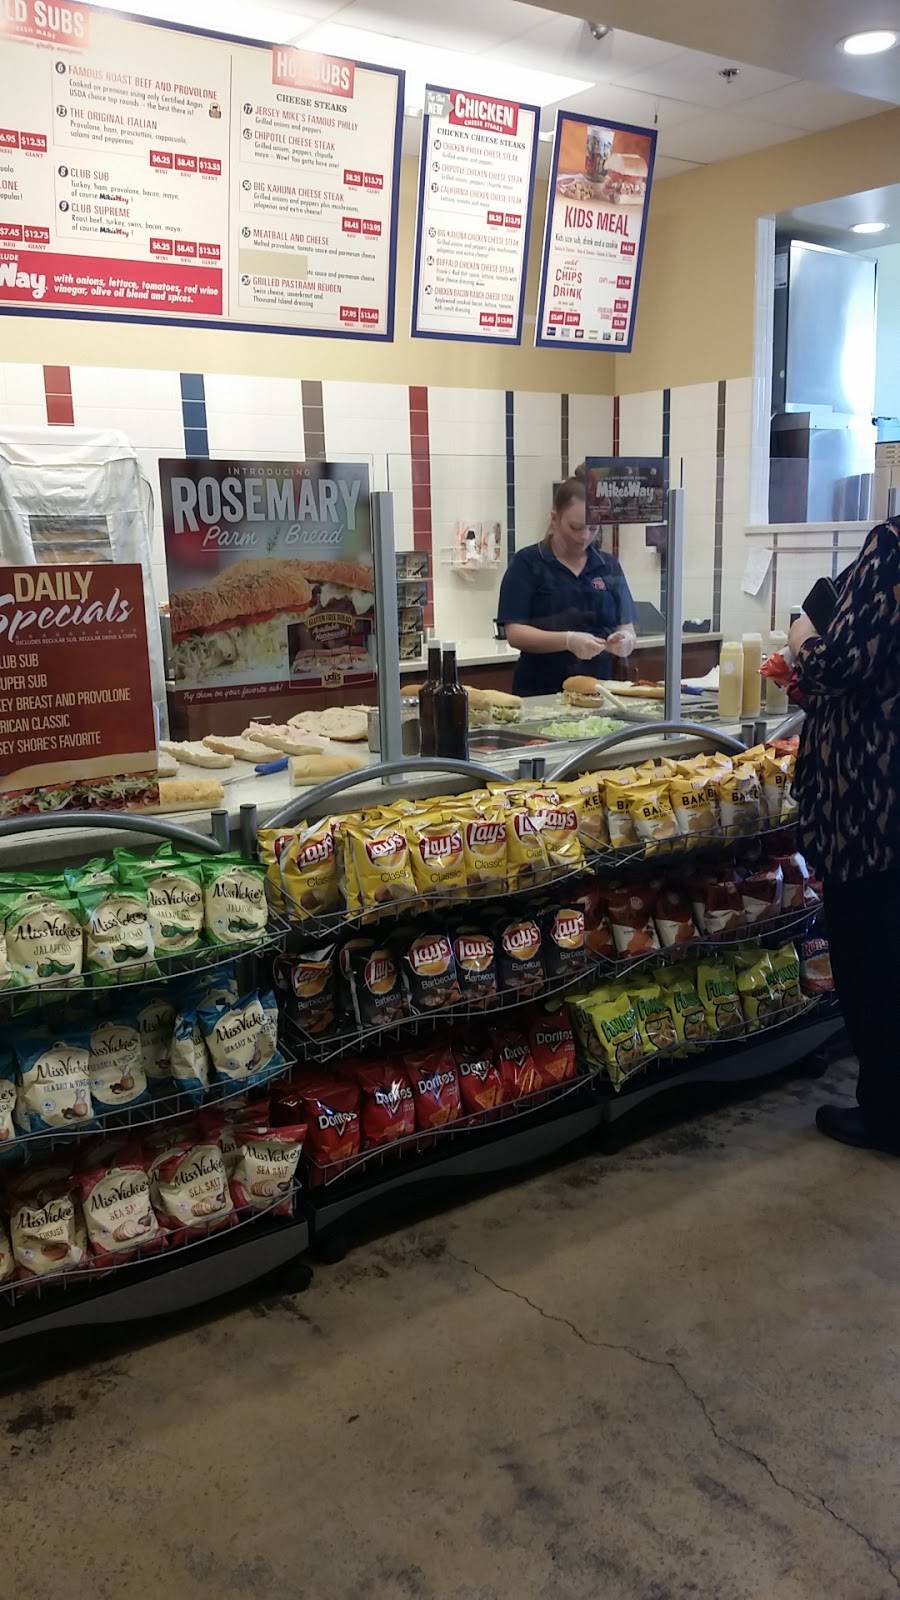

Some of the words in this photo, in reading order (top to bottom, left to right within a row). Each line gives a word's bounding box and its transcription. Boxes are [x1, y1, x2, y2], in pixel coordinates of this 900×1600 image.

[34, 1, 85, 38] SUBS
[69, 89, 86, 98] USDA
[135, 76, 153, 89] BEEF
[155, 80, 172, 92] AND
[174, 83, 217, 100] PROVOLONE
[161, 94, 185, 106] Certified
[276, 93, 312, 107] CHEESE
[314, 100, 347, 113] STEAKS
[70, 108, 85, 118] THE
[87, 109, 124, 125] ORIGINAL
[126, 117, 158, 130] ITALIAN
[255, 106, 280, 118] JERSEY
[282, 110, 306, 122] MIKE'S
[307, 115, 336, 128] FAMOUS
[337, 119, 358, 131] PHILLY
[454, 93, 514, 128] CHICKEN
[254, 131, 286, 144] CHIPOTLE
[288, 134, 313, 148] CHEESE
[315, 138, 336, 151] STEAK
[437, 128, 469, 140] CHICKEN
[471, 133, 497, 144] CHEESE
[500, 139, 526, 149] STEAKS
[70, 168, 90, 179] CLUB
[93, 170, 109, 181] SUB
[253, 181, 265, 191] BIG
[267, 182, 296, 195] KAHUNA
[298, 186, 321, 199] CHEESE
[323, 190, 345, 201] STEAK
[71, 203, 91, 214] CLUB
[93, 205, 131, 218] SUPREME
[564, 205, 594, 228] KIDS
[596, 211, 629, 237] MEAL
[253, 229, 288, 242] MEATBALL
[290, 232, 304, 242] AND
[306, 234, 329, 245] CHEESE
[53, 273, 73, 284] with
[76, 276, 106, 287] onions,
[108, 277, 138, 289] lettuce,
[141, 281, 182, 294] tomatoes,
[183, 284, 198, 294] red
[199, 286, 218, 296] wine
[252, 276, 279, 287] GRILLED
[281, 278, 316, 291] PASTRAMI
[317, 282, 342, 293] REUBEN
[555, 268, 583, 284] CHIPS
[53, 284, 89, 297] vinegar,
[91, 286, 111, 296] olive
[113, 288, 124, 297] oil
[126, 289, 148, 299] blend
[150, 291, 166, 300] and
[168, 294, 194, 304] spices.
[553, 284, 582, 300] DRINK
[228, 466, 311, 477] INTRODUCING
[170, 476, 361, 535] ROSEMARY
[202, 525, 258, 547] Parm
[285, 523, 346, 545] Bread
[13, 570, 93, 603] DAILY
[19, 653, 39, 668] SUB
[28, 674, 48, 688] SUB
[16, 694, 53, 711] BREAST
[55, 692, 76, 707] AND
[77, 687, 131, 706] PROVOLONE
[31, 713, 71, 731] CLASSIC
[17, 735, 57, 753] SHORE'S
[59, 730, 101, 748] FAVORITE
[536, 1029, 573, 1045] Doritos
[418, 1070, 455, 1094] Doritos
[375, 1086, 413, 1105] Doritos
[318, 1112, 357, 1130] Doritos
[256, 1165, 270, 1175] SEA
[190, 1185, 204, 1198] SEA
[205, 1178, 222, 1192] SALT
